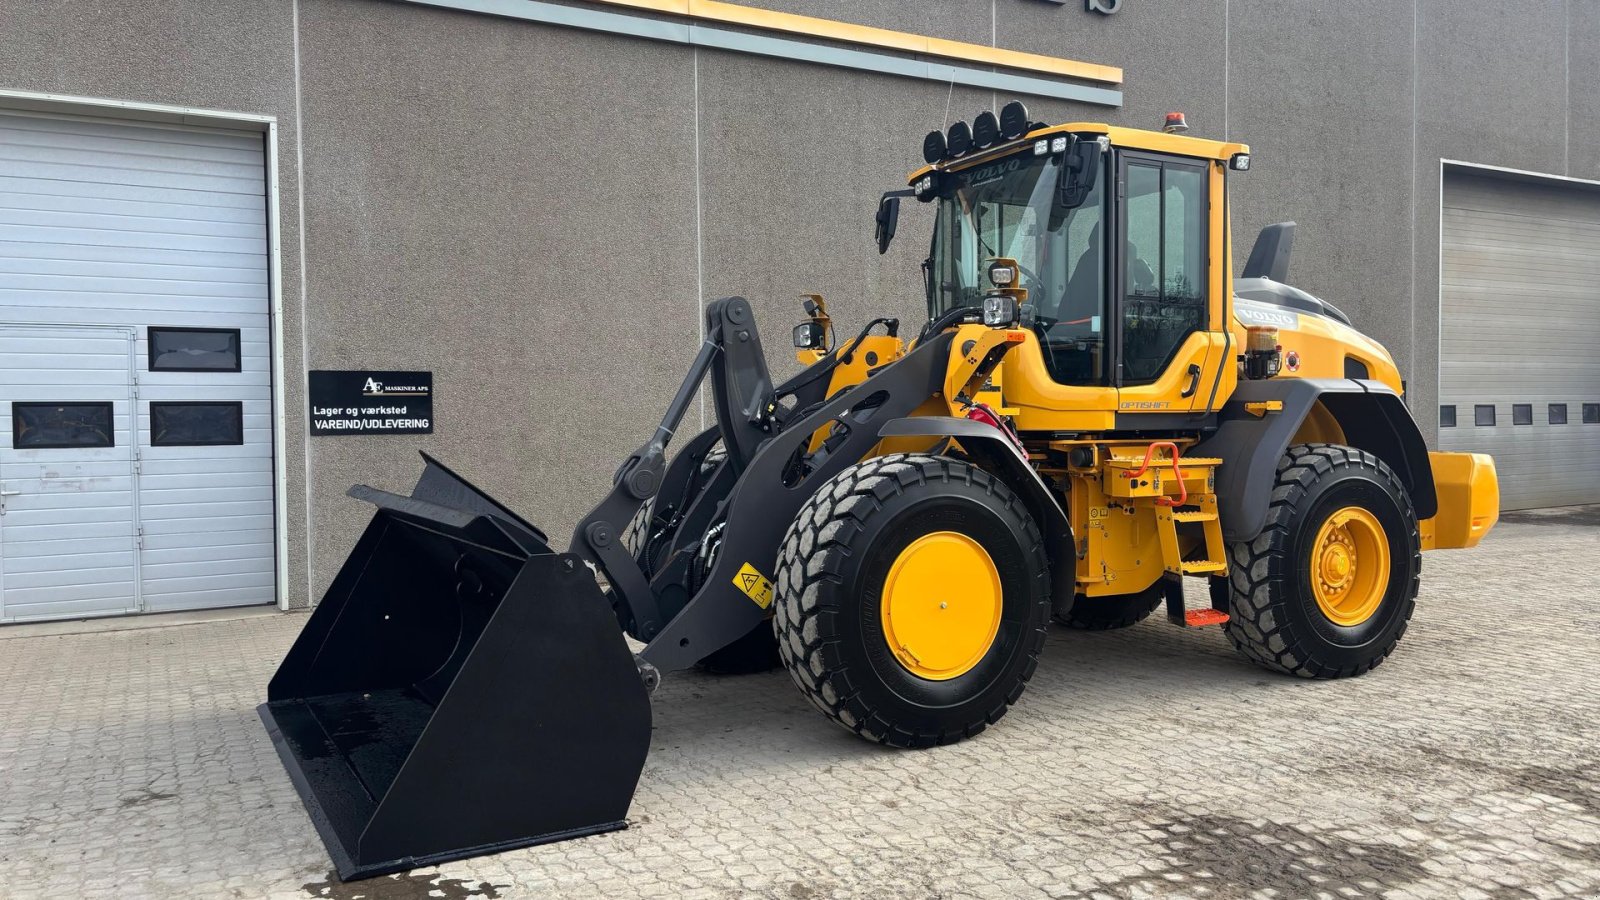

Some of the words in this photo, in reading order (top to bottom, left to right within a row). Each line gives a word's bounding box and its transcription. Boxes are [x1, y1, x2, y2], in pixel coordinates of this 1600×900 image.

[967, 159, 1020, 184] VOLVO
[1239, 309, 1294, 324] VOLVO
[313, 406, 343, 417] Lager
[361, 405, 407, 415] værksted
[1120, 401, 1171, 409] OPTISHIFT
[314, 418, 429, 430] VAREIND/UDLEVERING
